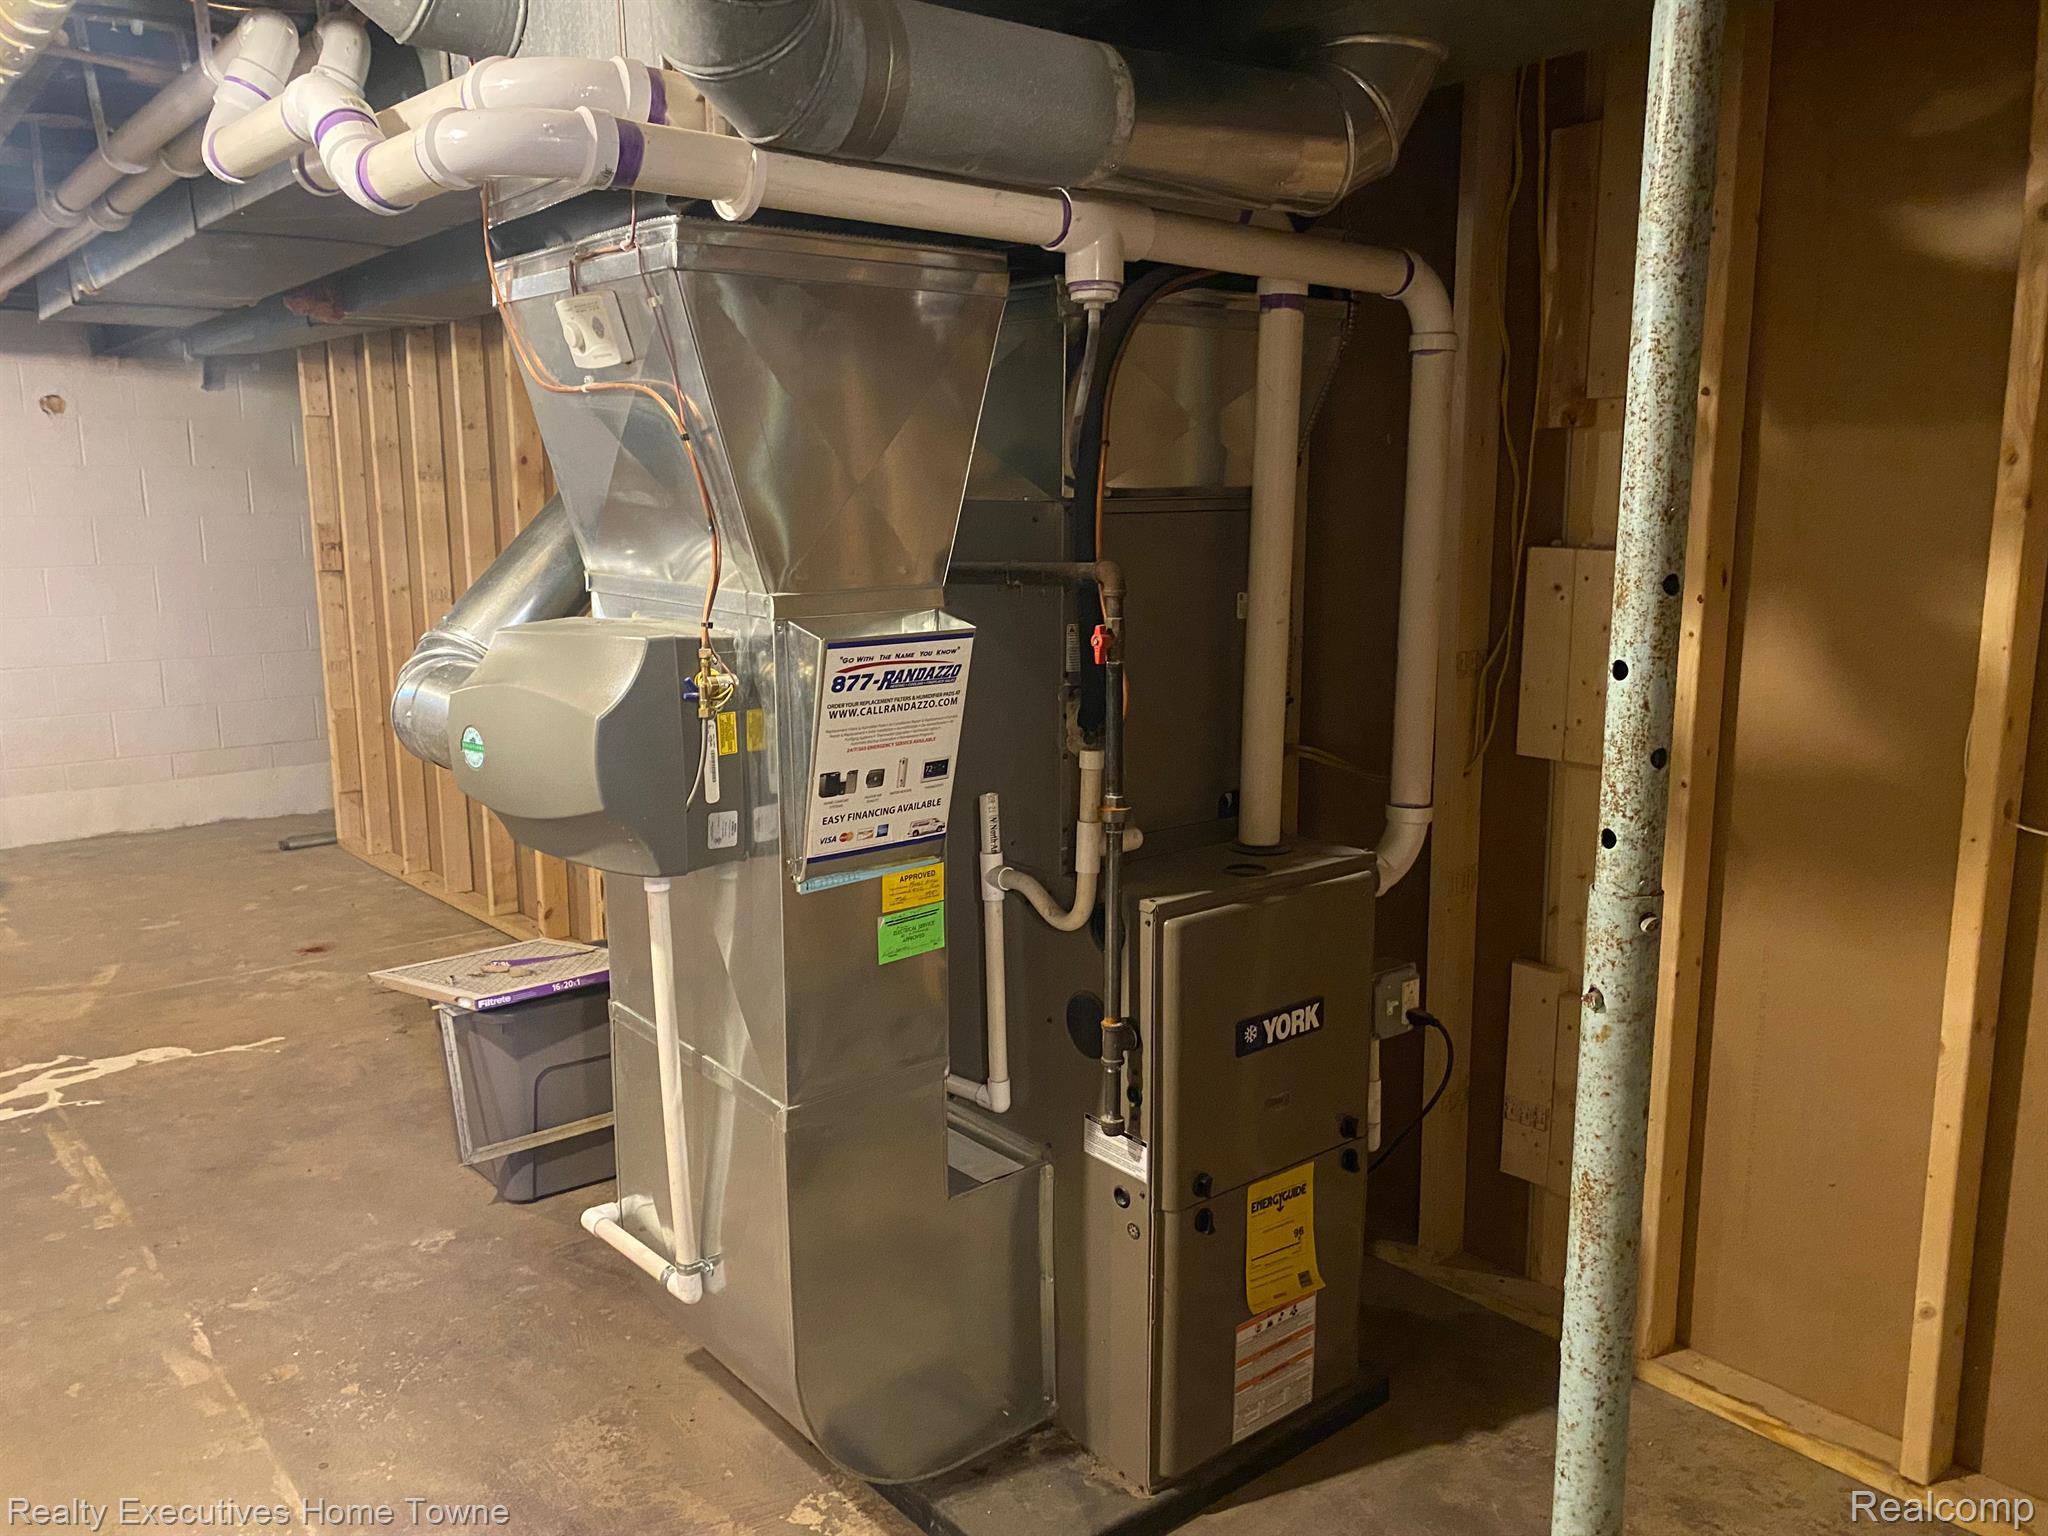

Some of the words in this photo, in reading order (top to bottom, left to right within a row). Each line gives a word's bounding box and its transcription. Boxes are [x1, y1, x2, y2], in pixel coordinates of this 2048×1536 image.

[831, 664, 962, 693] 877-RANDAZZO
[860, 698, 894, 706] REPLACEMENT
[916, 692, 943, 700] HUMIDIFIER
[829, 697, 958, 719] WWW.CALLRANDAZZO.COM
[822, 815, 846, 826] EASY
[847, 806, 895, 821] FINANCING
[897, 798, 942, 813] AVAILABLE
[820, 836, 837, 845] VISA
[899, 870, 936, 883] APPROVED
[478, 995, 511, 1009] Filtrete
[1263, 1002, 1320, 1044] YORK
[1294, 1225, 1304, 1238] 96
